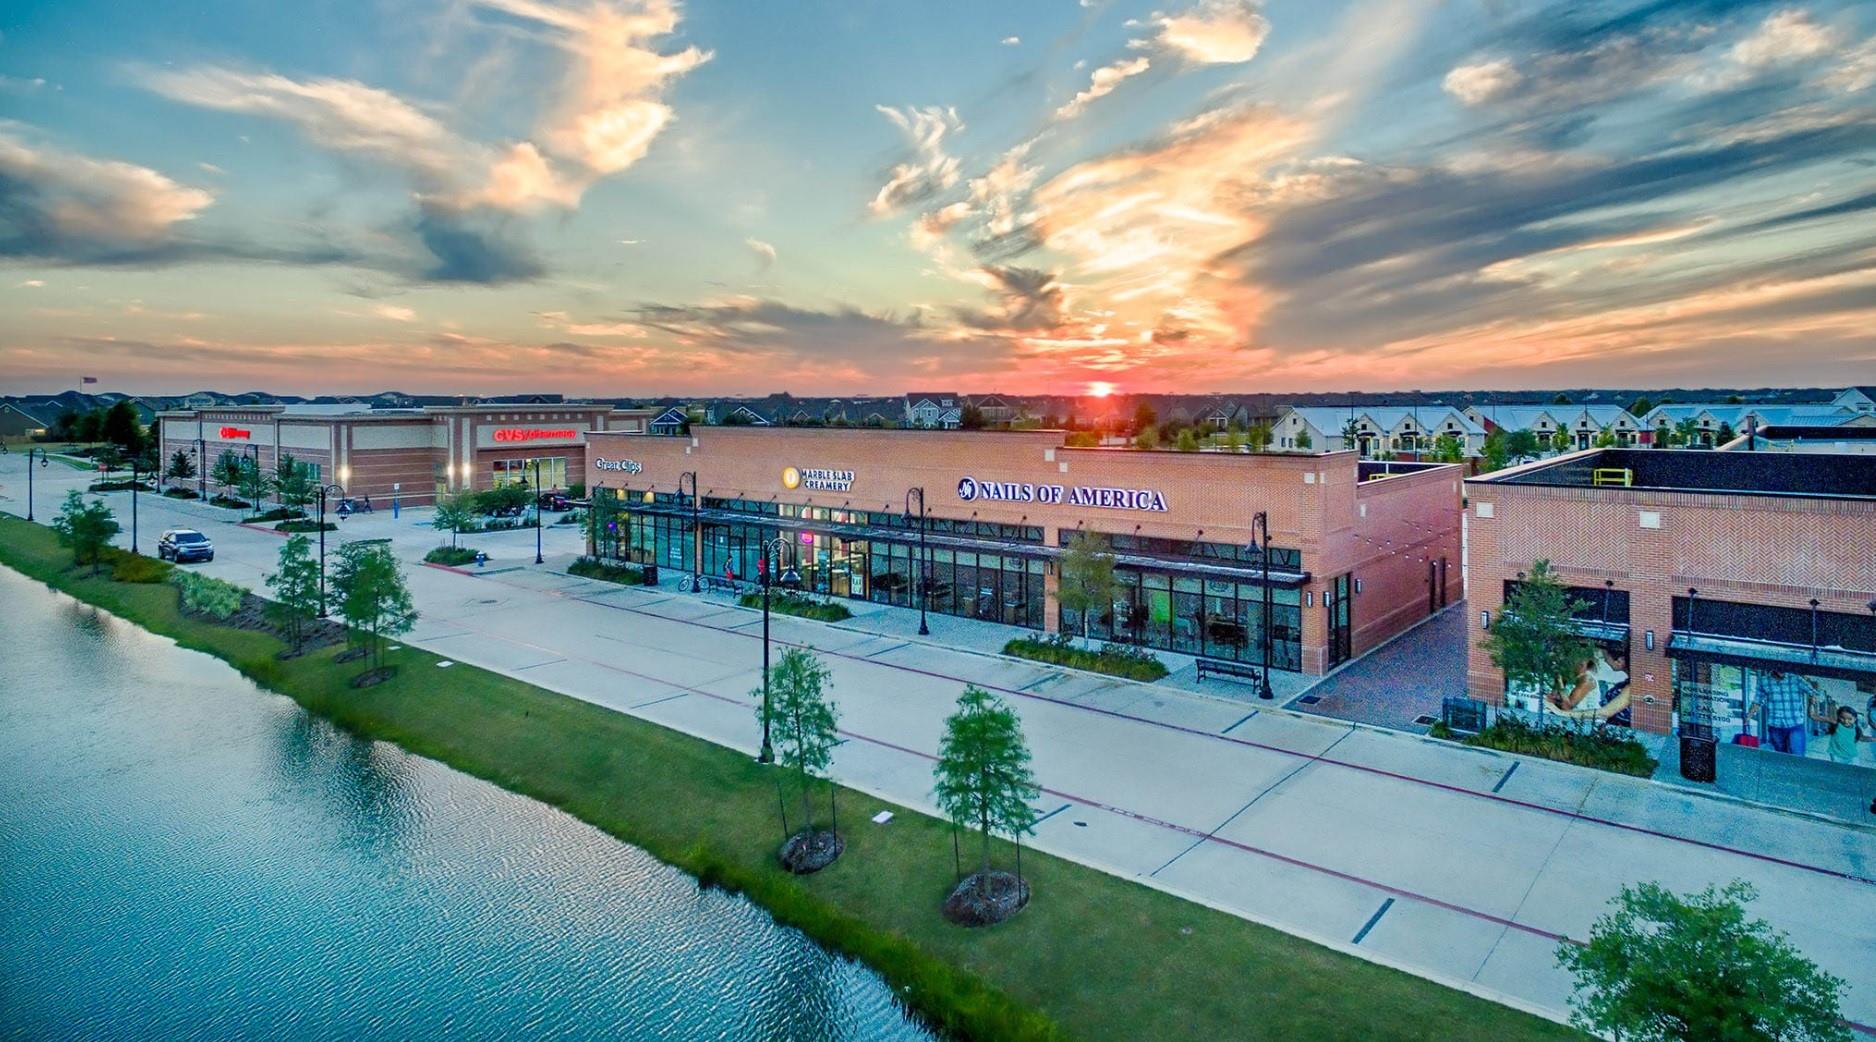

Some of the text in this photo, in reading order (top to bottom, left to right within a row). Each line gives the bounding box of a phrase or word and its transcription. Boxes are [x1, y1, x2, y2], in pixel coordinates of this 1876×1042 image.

[595, 457, 642, 475] Great Clips
[801, 470, 853, 481] MARBLE SLAB
[804, 480, 849, 491] CREAMERY
[980, 482, 1167, 511] NAILS OF AMERICA
